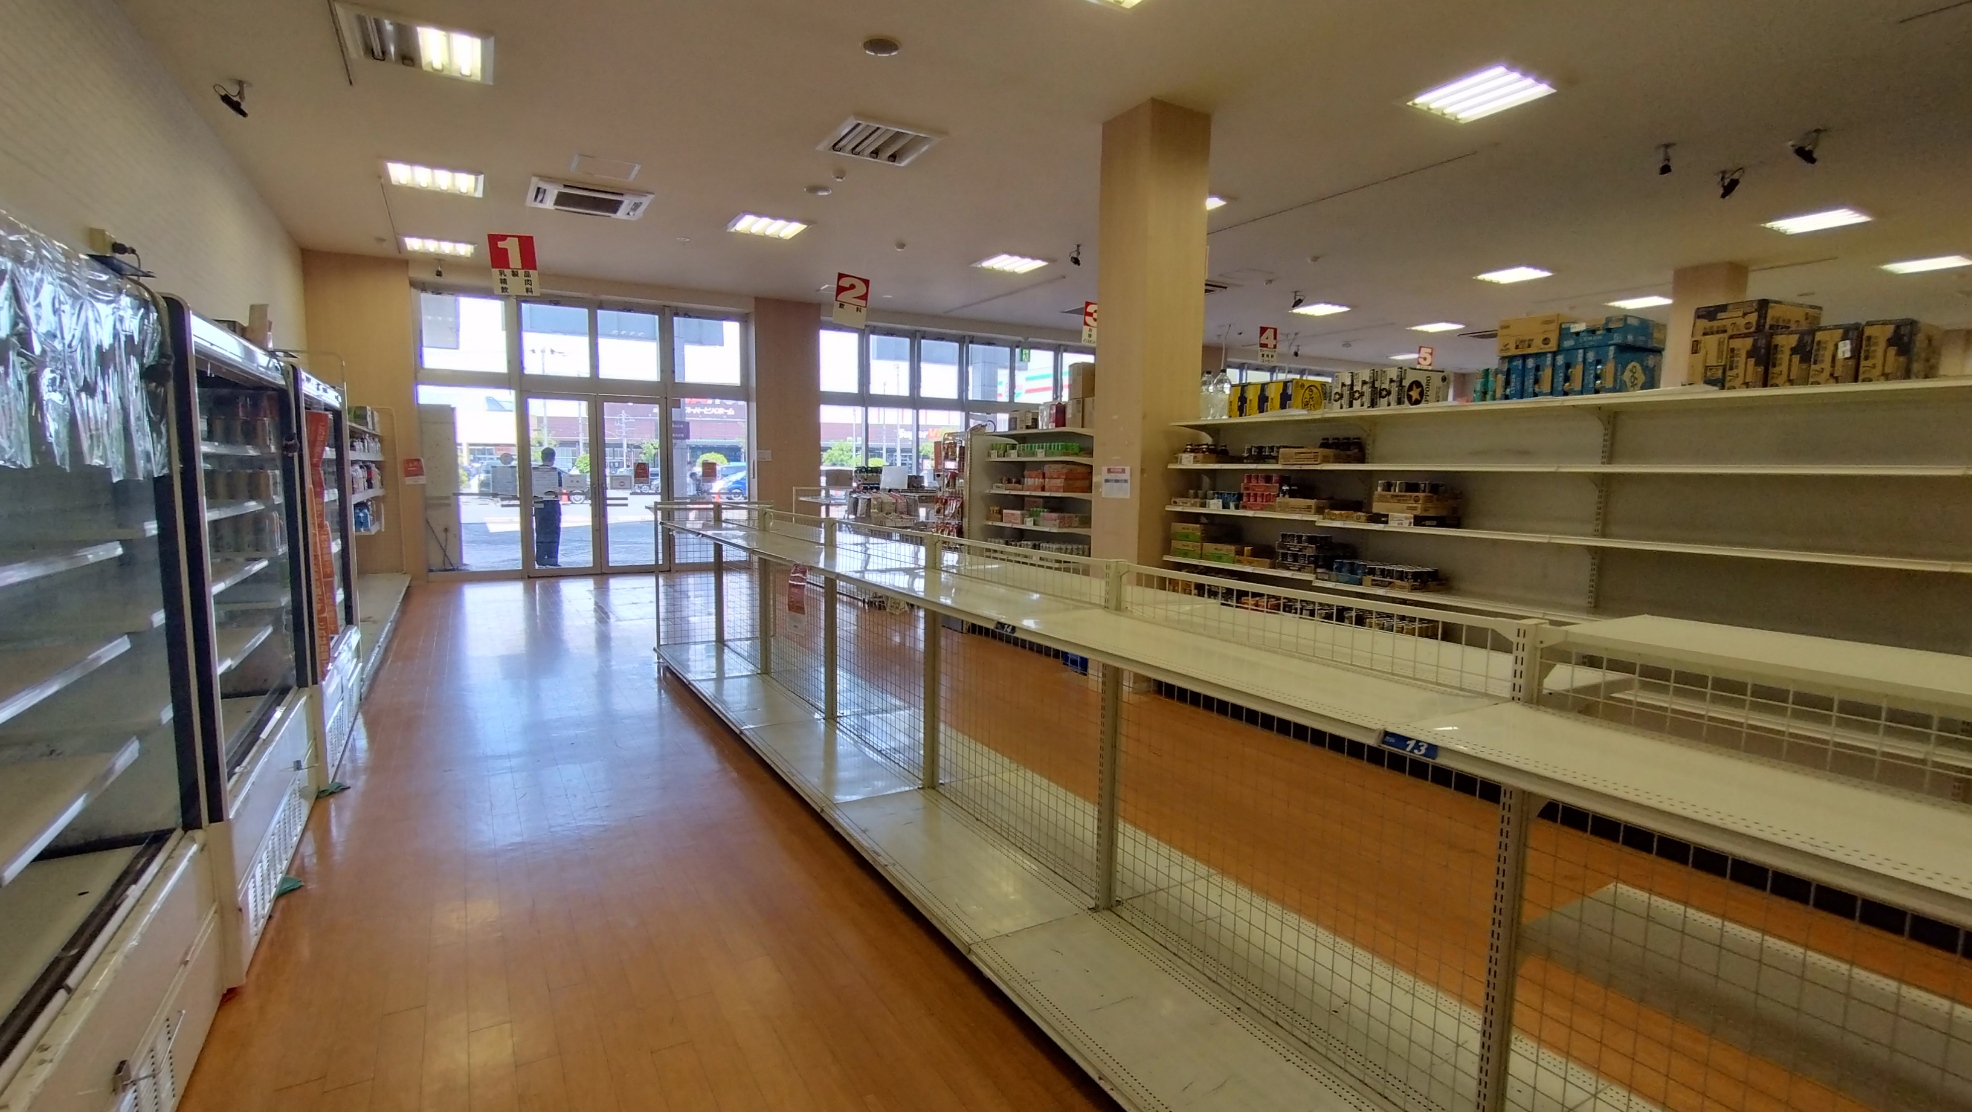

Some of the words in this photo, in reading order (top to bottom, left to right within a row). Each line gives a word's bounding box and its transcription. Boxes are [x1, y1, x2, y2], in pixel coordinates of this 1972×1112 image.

[497, 236, 522, 269] 1
[498, 269, 532, 278] 乳製品
[500, 286, 534, 295] 飲料
[837, 276, 867, 307] 2
[1085, 304, 1098, 327] 3
[1260, 328, 1277, 348] 4
[1417, 346, 1433, 366] 5
[1405, 740, 1428, 755] 13
